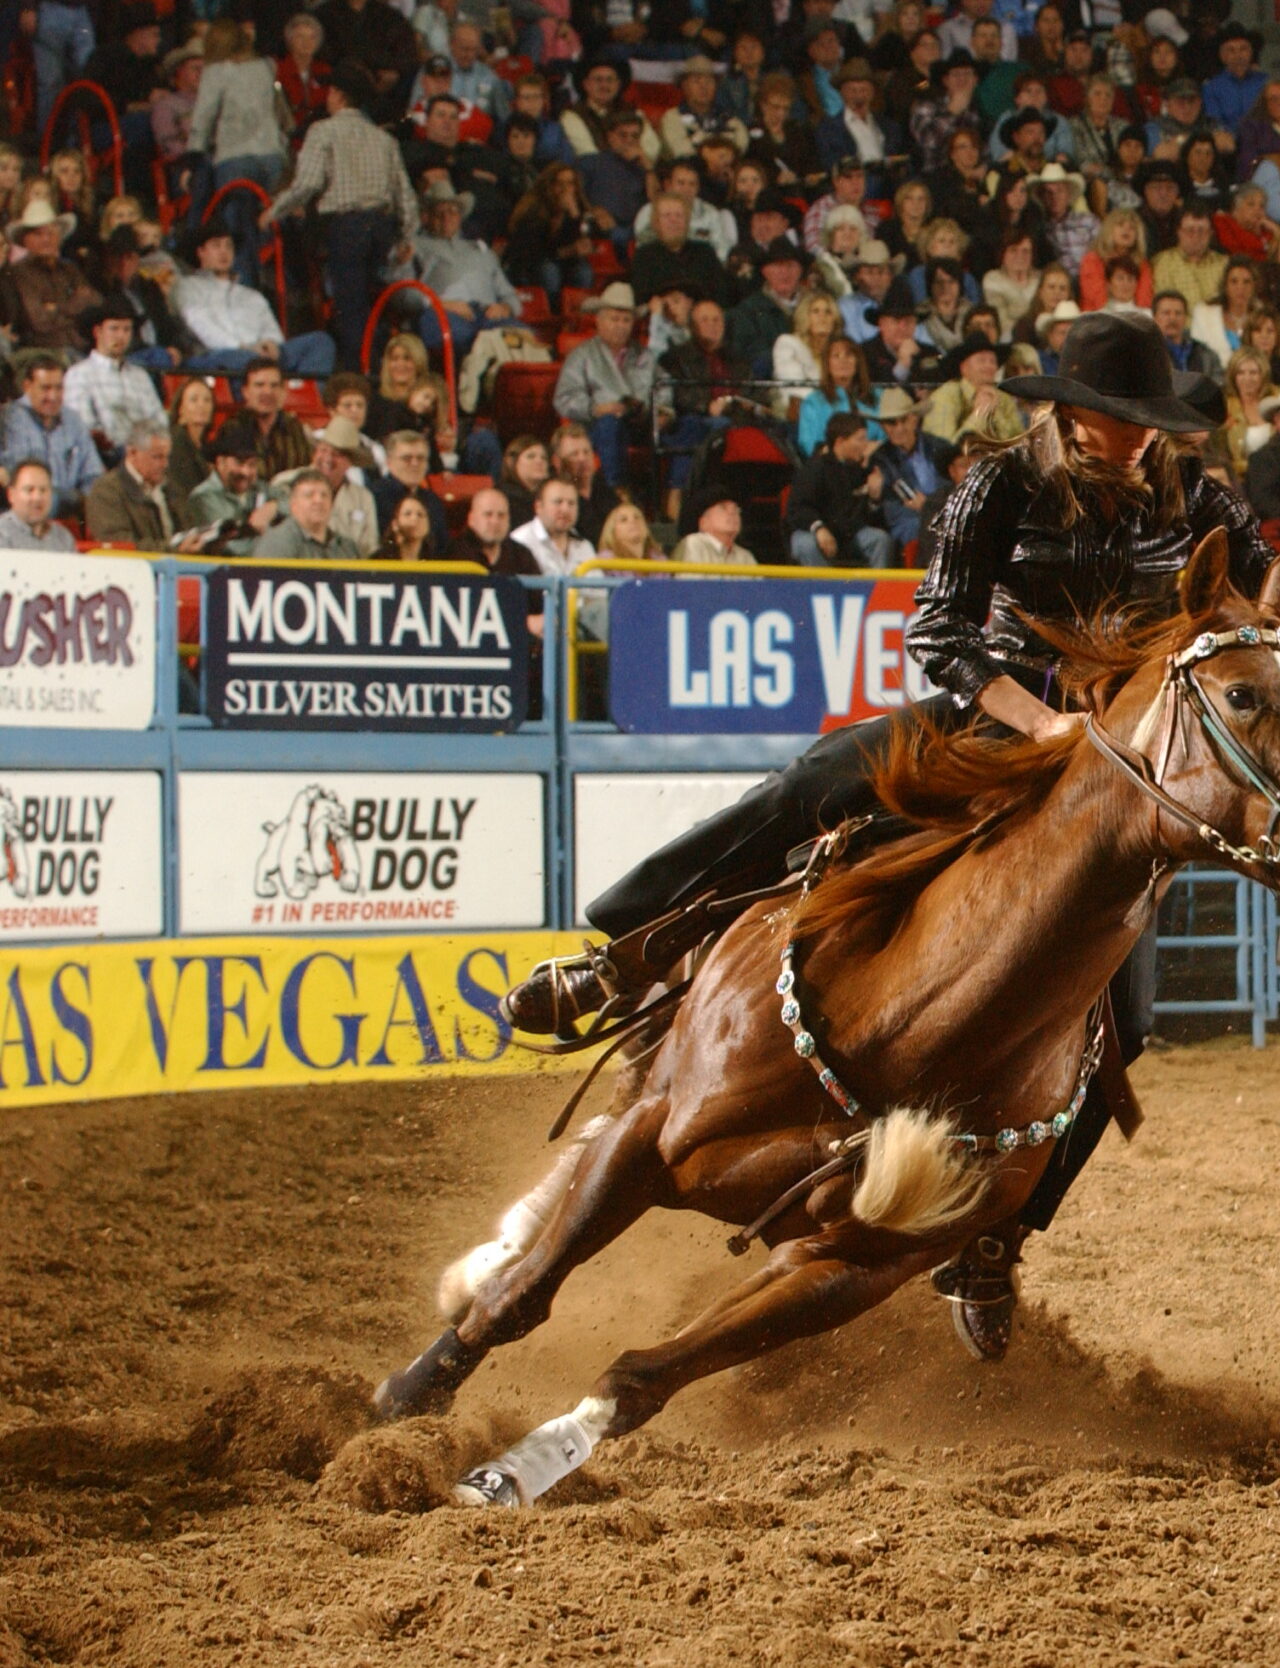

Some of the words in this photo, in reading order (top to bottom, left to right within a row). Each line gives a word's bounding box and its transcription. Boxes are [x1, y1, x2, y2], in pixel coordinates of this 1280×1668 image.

[0, 585, 134, 667] USHER
[227, 578, 510, 649] MONTANA
[668, 610, 794, 708] LAS
[23, 797, 114, 842] BULLY
[352, 798, 477, 841] BULLY
[36, 850, 100, 895] DOG
[370, 847, 458, 891] DOG
[0, 906, 98, 928] ERFORMANCE
[252, 902, 275, 923] #1
[282, 902, 303, 922] IN
[310, 900, 456, 922] PERFORMANCE
[134, 948, 512, 1074] VEGAS
